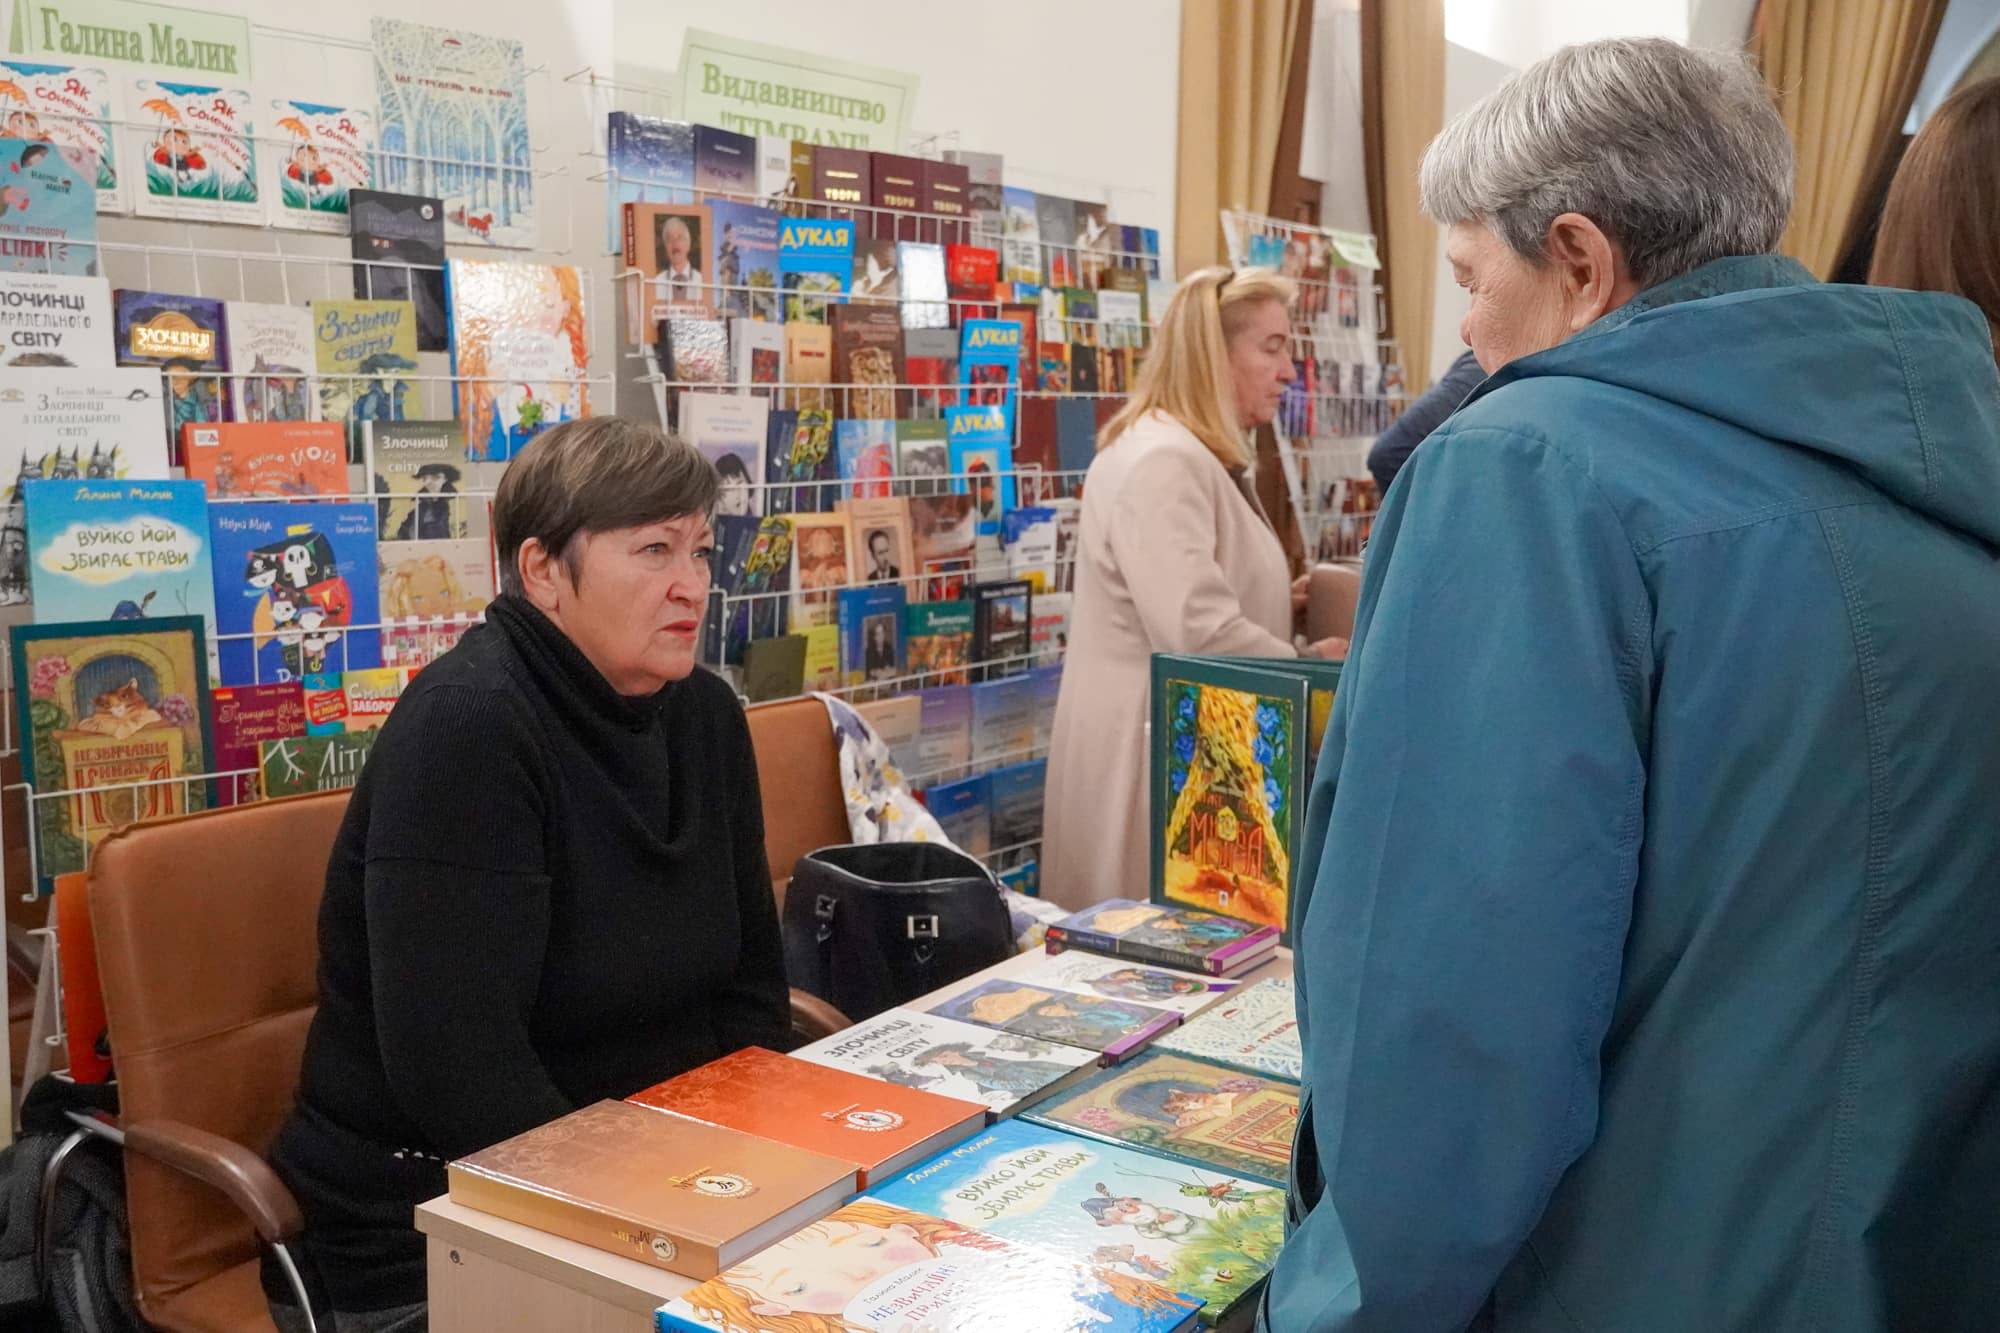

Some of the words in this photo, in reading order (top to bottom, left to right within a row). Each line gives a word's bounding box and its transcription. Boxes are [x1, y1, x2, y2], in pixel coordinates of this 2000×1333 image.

[40, 8, 144, 62] Галина
[149, 23, 239, 74] Малик
[64, 78, 92, 101] Як
[702, 63, 886, 124] Видавництво
[212, 99, 238, 120] Як
[317, 307, 402, 343] Злочинці
[11, 331, 63, 348] СВІТУ
[382, 434, 448, 451] Злочинці
[74, 487, 123, 502] Галина
[128, 486, 175, 500] Малик
[77, 527, 135, 547] ВУЙКО
[141, 522, 177, 543] ЙОЙ
[134, 550, 189, 567] ТРАВИ
[886, 1038, 931, 1058] СВІТУ
[955, 1169, 1017, 1202] ВУЙКО
[1002, 1148, 1057, 1171] ЙОЙ
[974, 1180, 1046, 1221] ЗБИРАЄ
[1031, 1151, 1092, 1181] ТРАВИ
